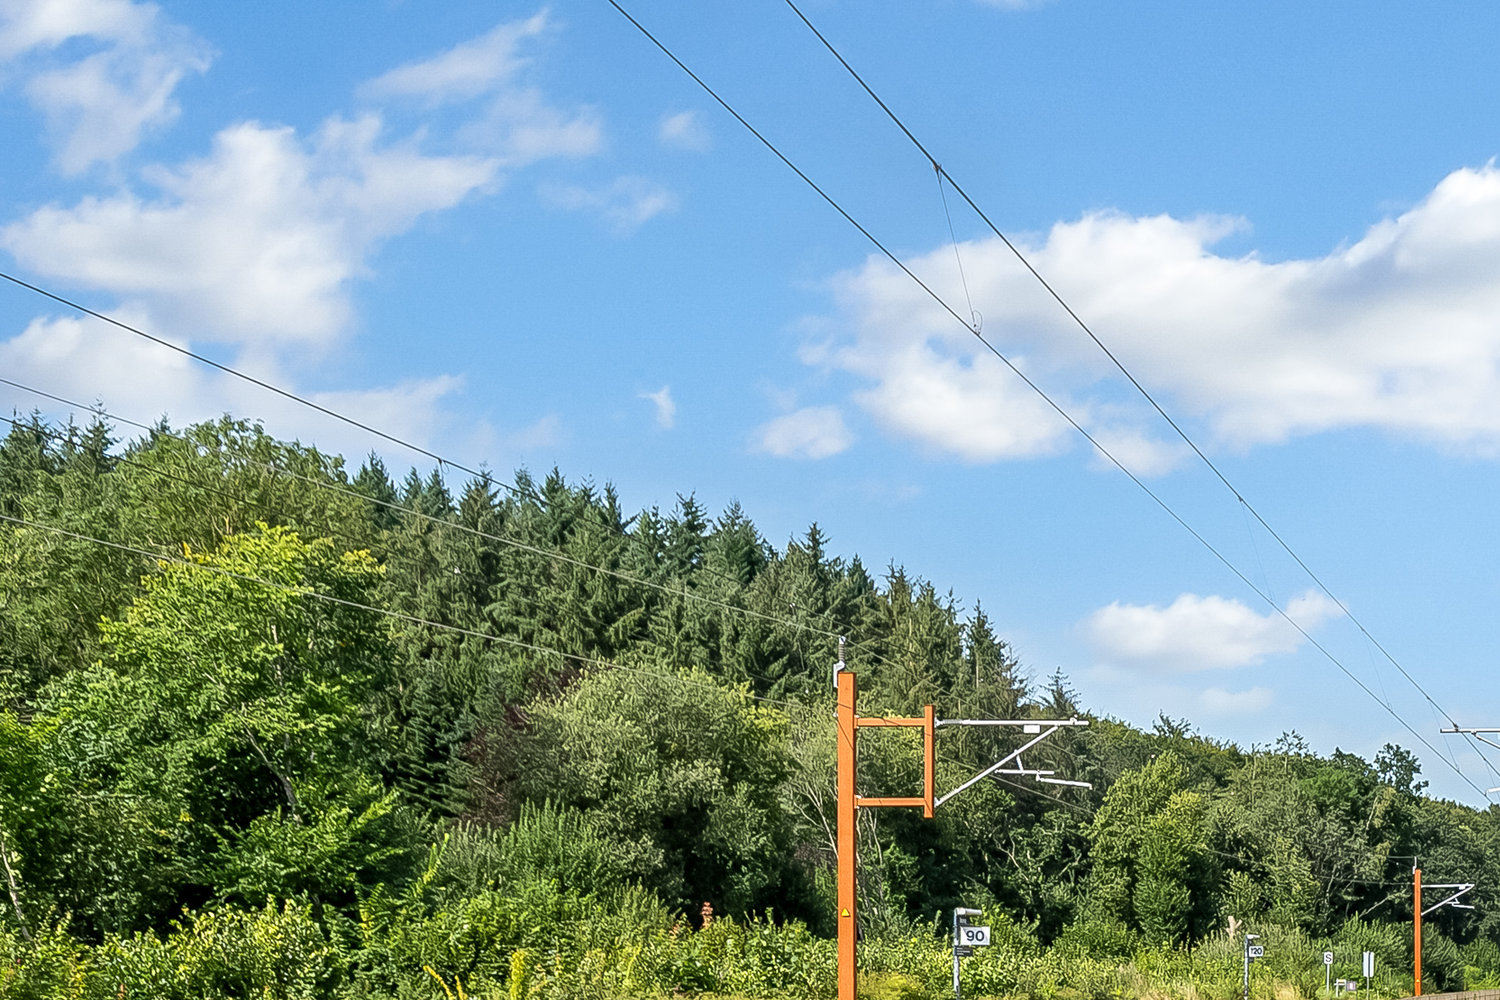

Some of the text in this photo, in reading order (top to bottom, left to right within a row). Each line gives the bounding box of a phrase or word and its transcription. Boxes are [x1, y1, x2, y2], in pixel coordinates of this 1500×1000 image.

[966, 930, 985, 942] 90
[1250, 947, 1262, 955] 120
[1325, 954, 1332, 962] S
